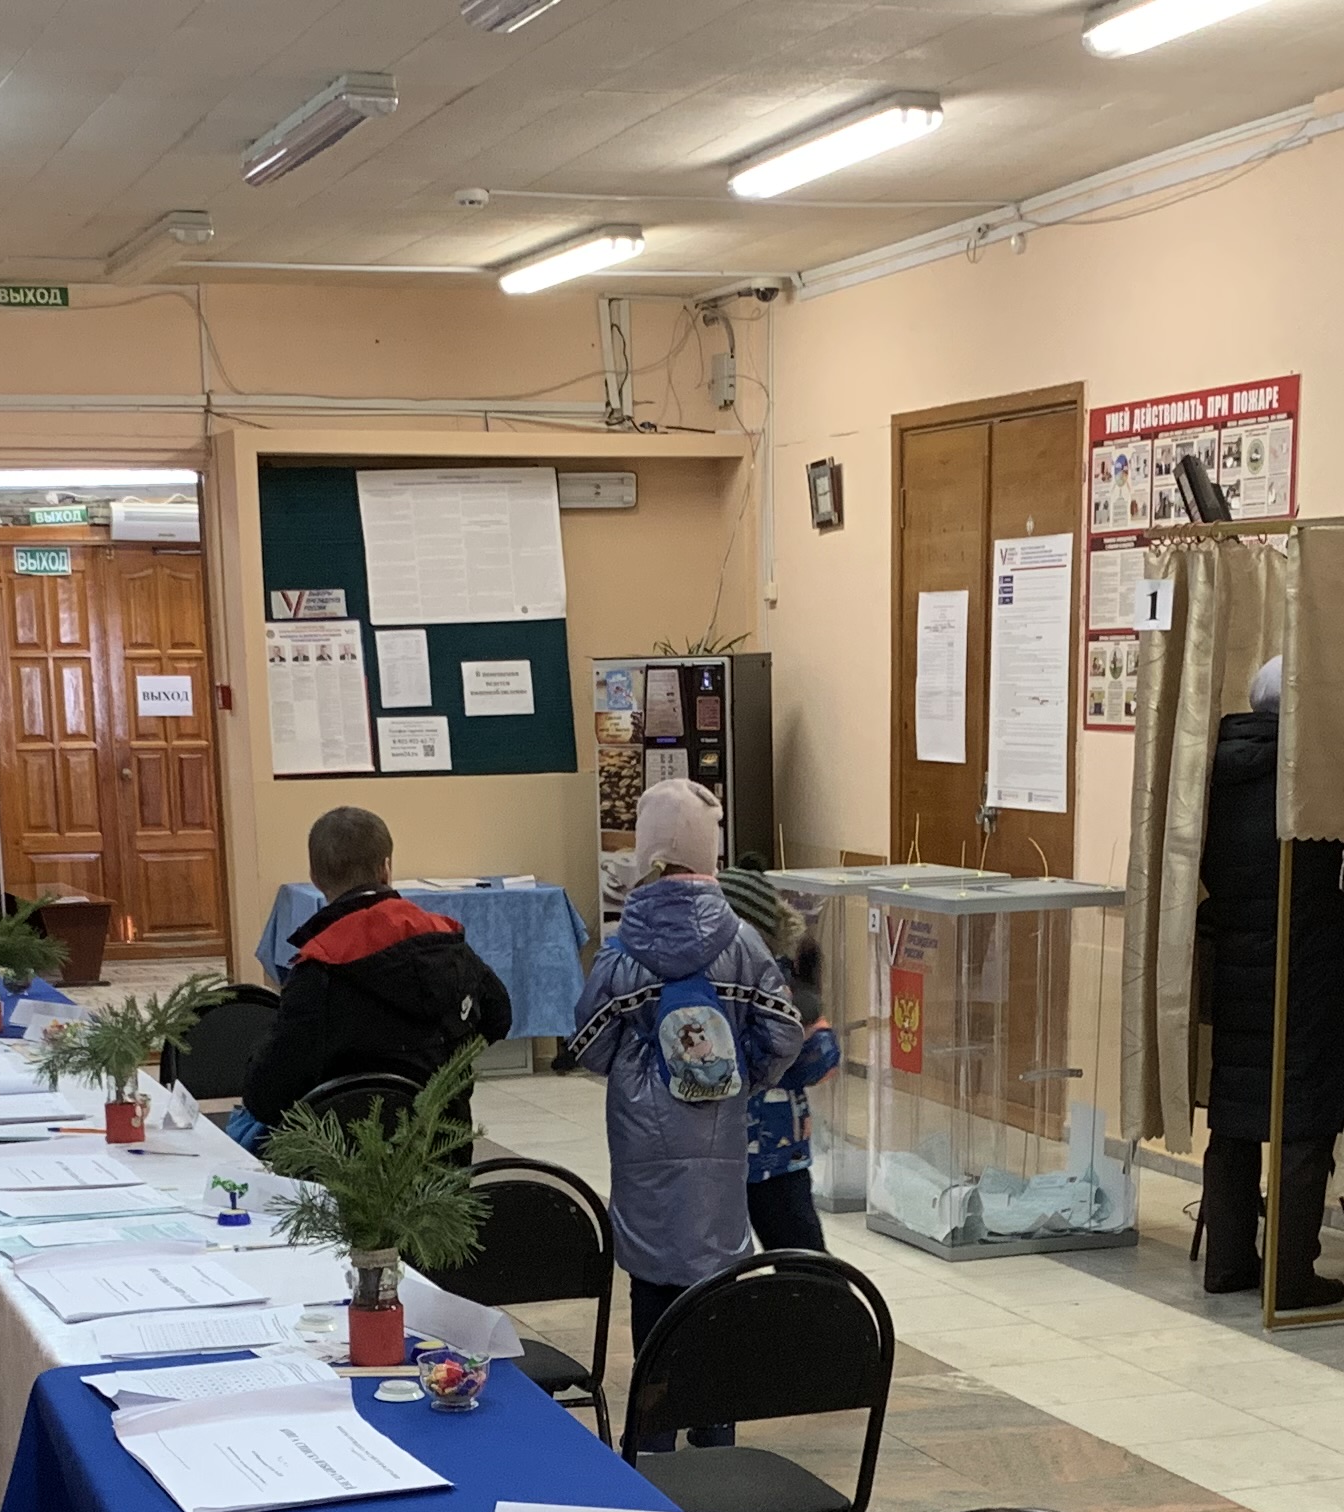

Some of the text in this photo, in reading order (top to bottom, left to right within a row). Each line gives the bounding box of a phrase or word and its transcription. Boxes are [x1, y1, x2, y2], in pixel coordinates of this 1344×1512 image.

[1105, 386, 1279, 434] УМЕЙ ДЕЙСТВОВАТЬ ПРИ ПОЖАРЕ
[35, 508, 84, 525] ВЫХОД
[17, 551, 69, 571] ВЫХОД
[1146, 591, 1160, 621] 1
[142, 690, 190, 702] ВЫХОД
